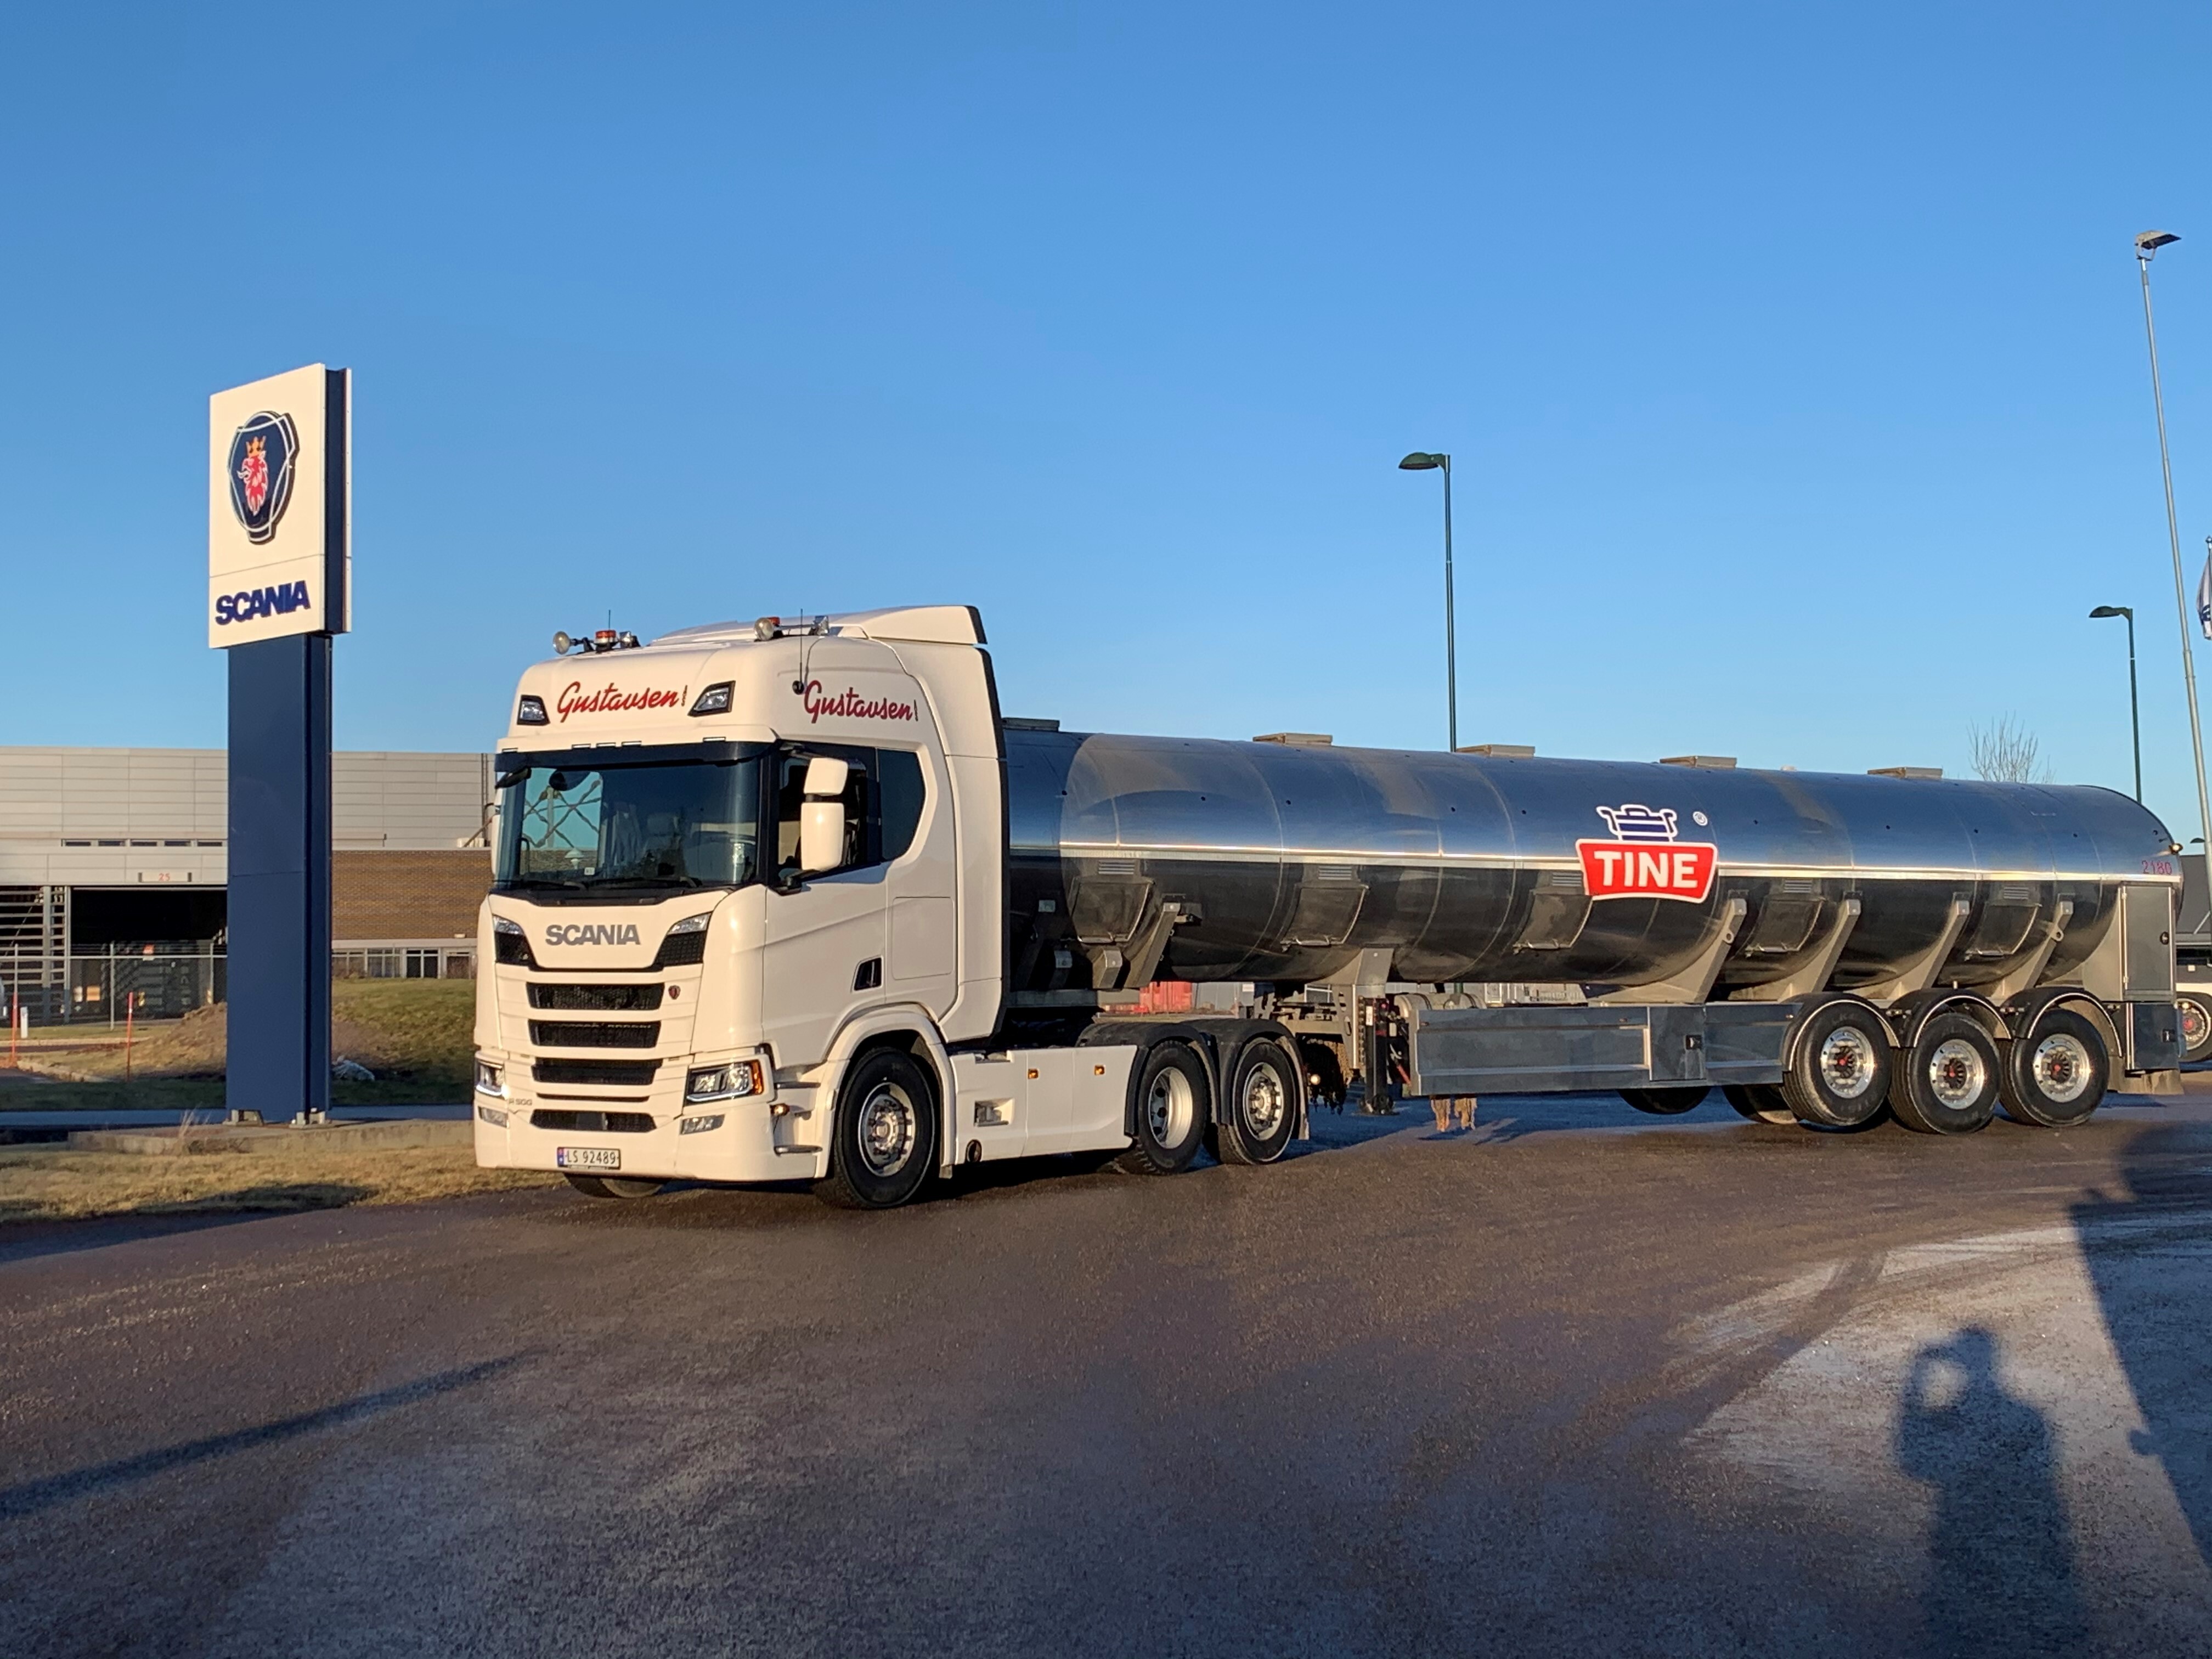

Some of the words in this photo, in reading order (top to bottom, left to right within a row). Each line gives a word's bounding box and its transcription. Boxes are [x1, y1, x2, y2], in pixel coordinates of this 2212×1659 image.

[215, 580, 311, 625] SCANIA
[159, 872, 170, 882] 25
[1594, 850, 1699, 888] TINE
[545, 924, 641, 946] SCANIA
[567, 1150, 578, 1163] LS
[583, 1151, 616, 1165] 92489
